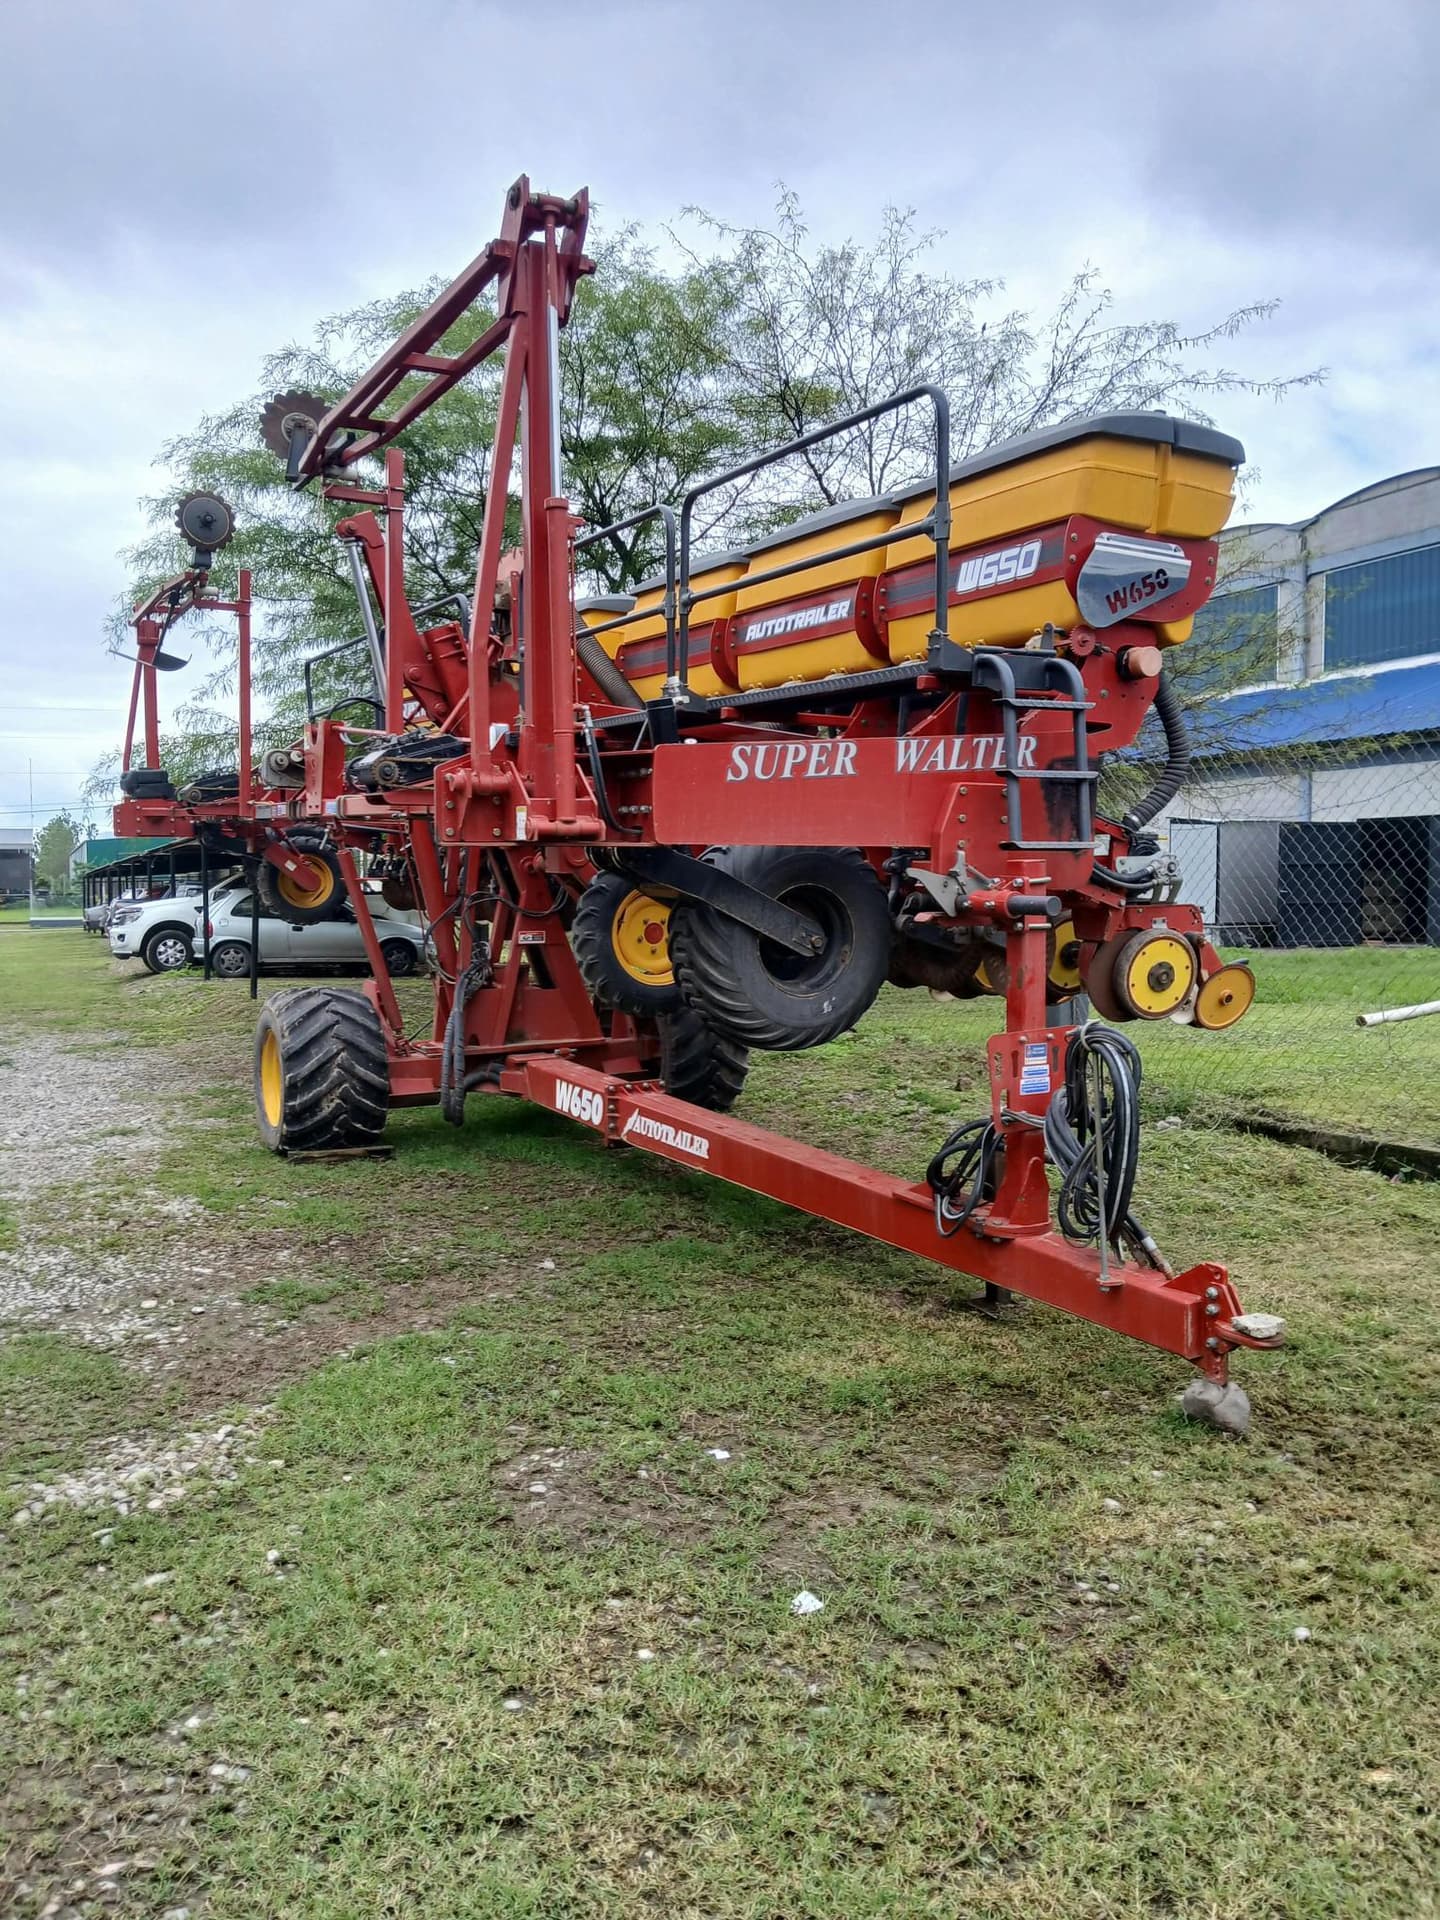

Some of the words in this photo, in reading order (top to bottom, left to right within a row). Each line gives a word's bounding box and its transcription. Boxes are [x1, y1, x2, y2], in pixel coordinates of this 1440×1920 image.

[956, 538, 1042, 595] W650
[1105, 567, 1169, 615] W650
[745, 599, 851, 642] AUTOTRAILER
[726, 741, 858, 782] SUPER
[896, 735, 1038, 773] WALTER
[555, 1078, 604, 1125] W650
[621, 1108, 710, 1159] AUTOTRAILER
